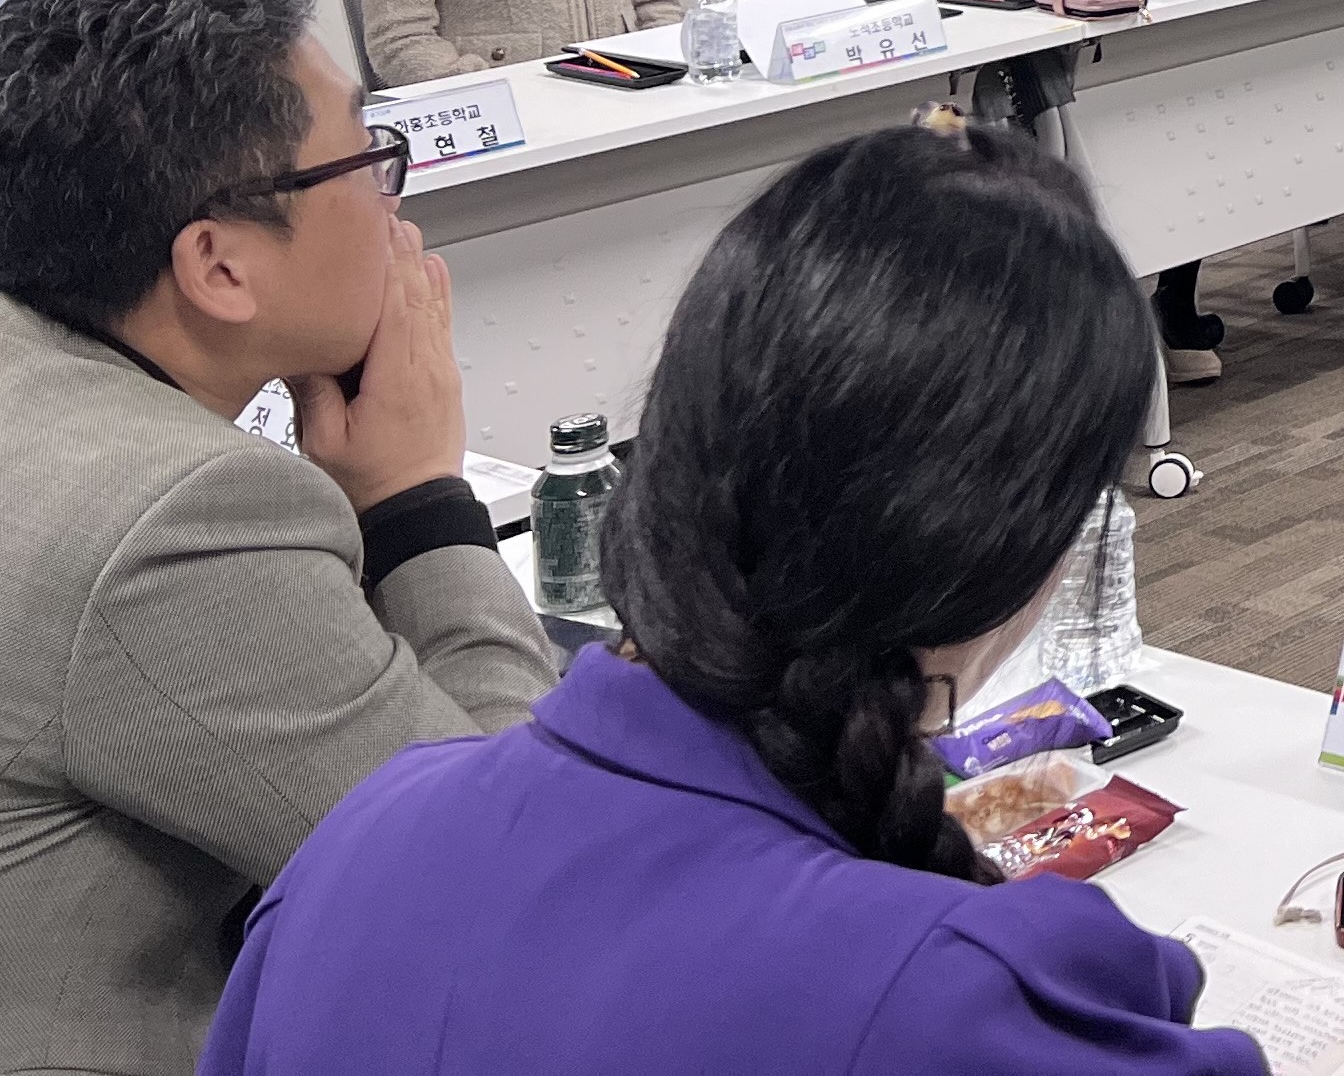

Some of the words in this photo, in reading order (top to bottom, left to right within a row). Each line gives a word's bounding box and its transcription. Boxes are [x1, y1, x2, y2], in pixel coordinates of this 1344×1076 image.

[846, 45, 863, 65] 박
[880, 38, 894, 59] 유
[911, 31, 927, 51] 선
[434, 133, 457, 157] 현
[476, 124, 499, 147] 철
